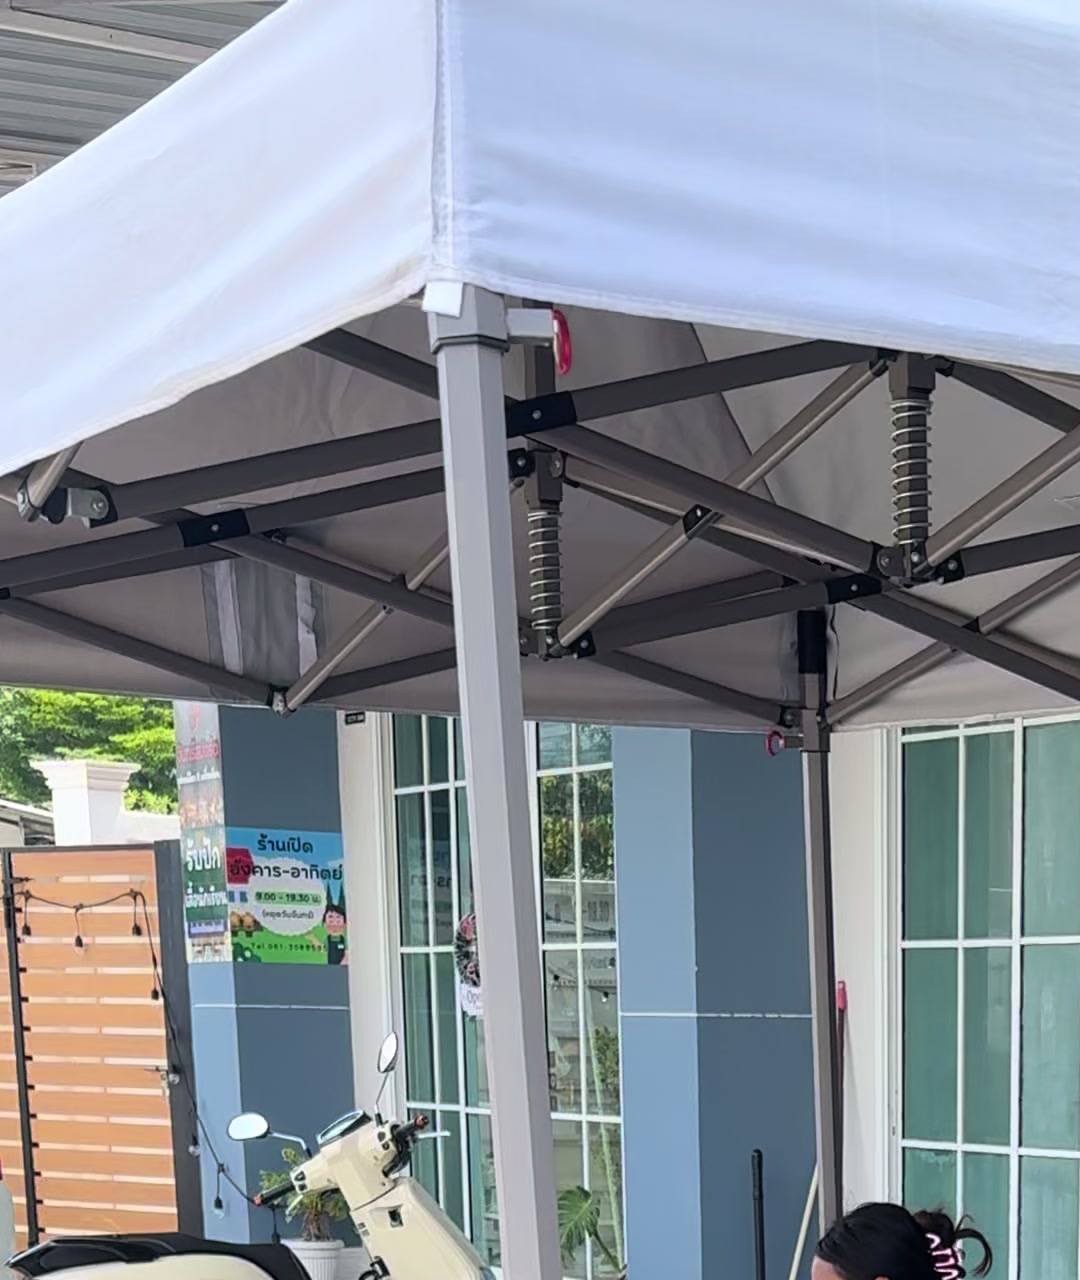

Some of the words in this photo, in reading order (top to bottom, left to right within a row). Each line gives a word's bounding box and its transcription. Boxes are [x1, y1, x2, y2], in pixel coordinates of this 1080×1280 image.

[257, 832, 314, 854] ร้านเปิด
[229, 858, 344, 881] อังคาร-อาทิตย์
